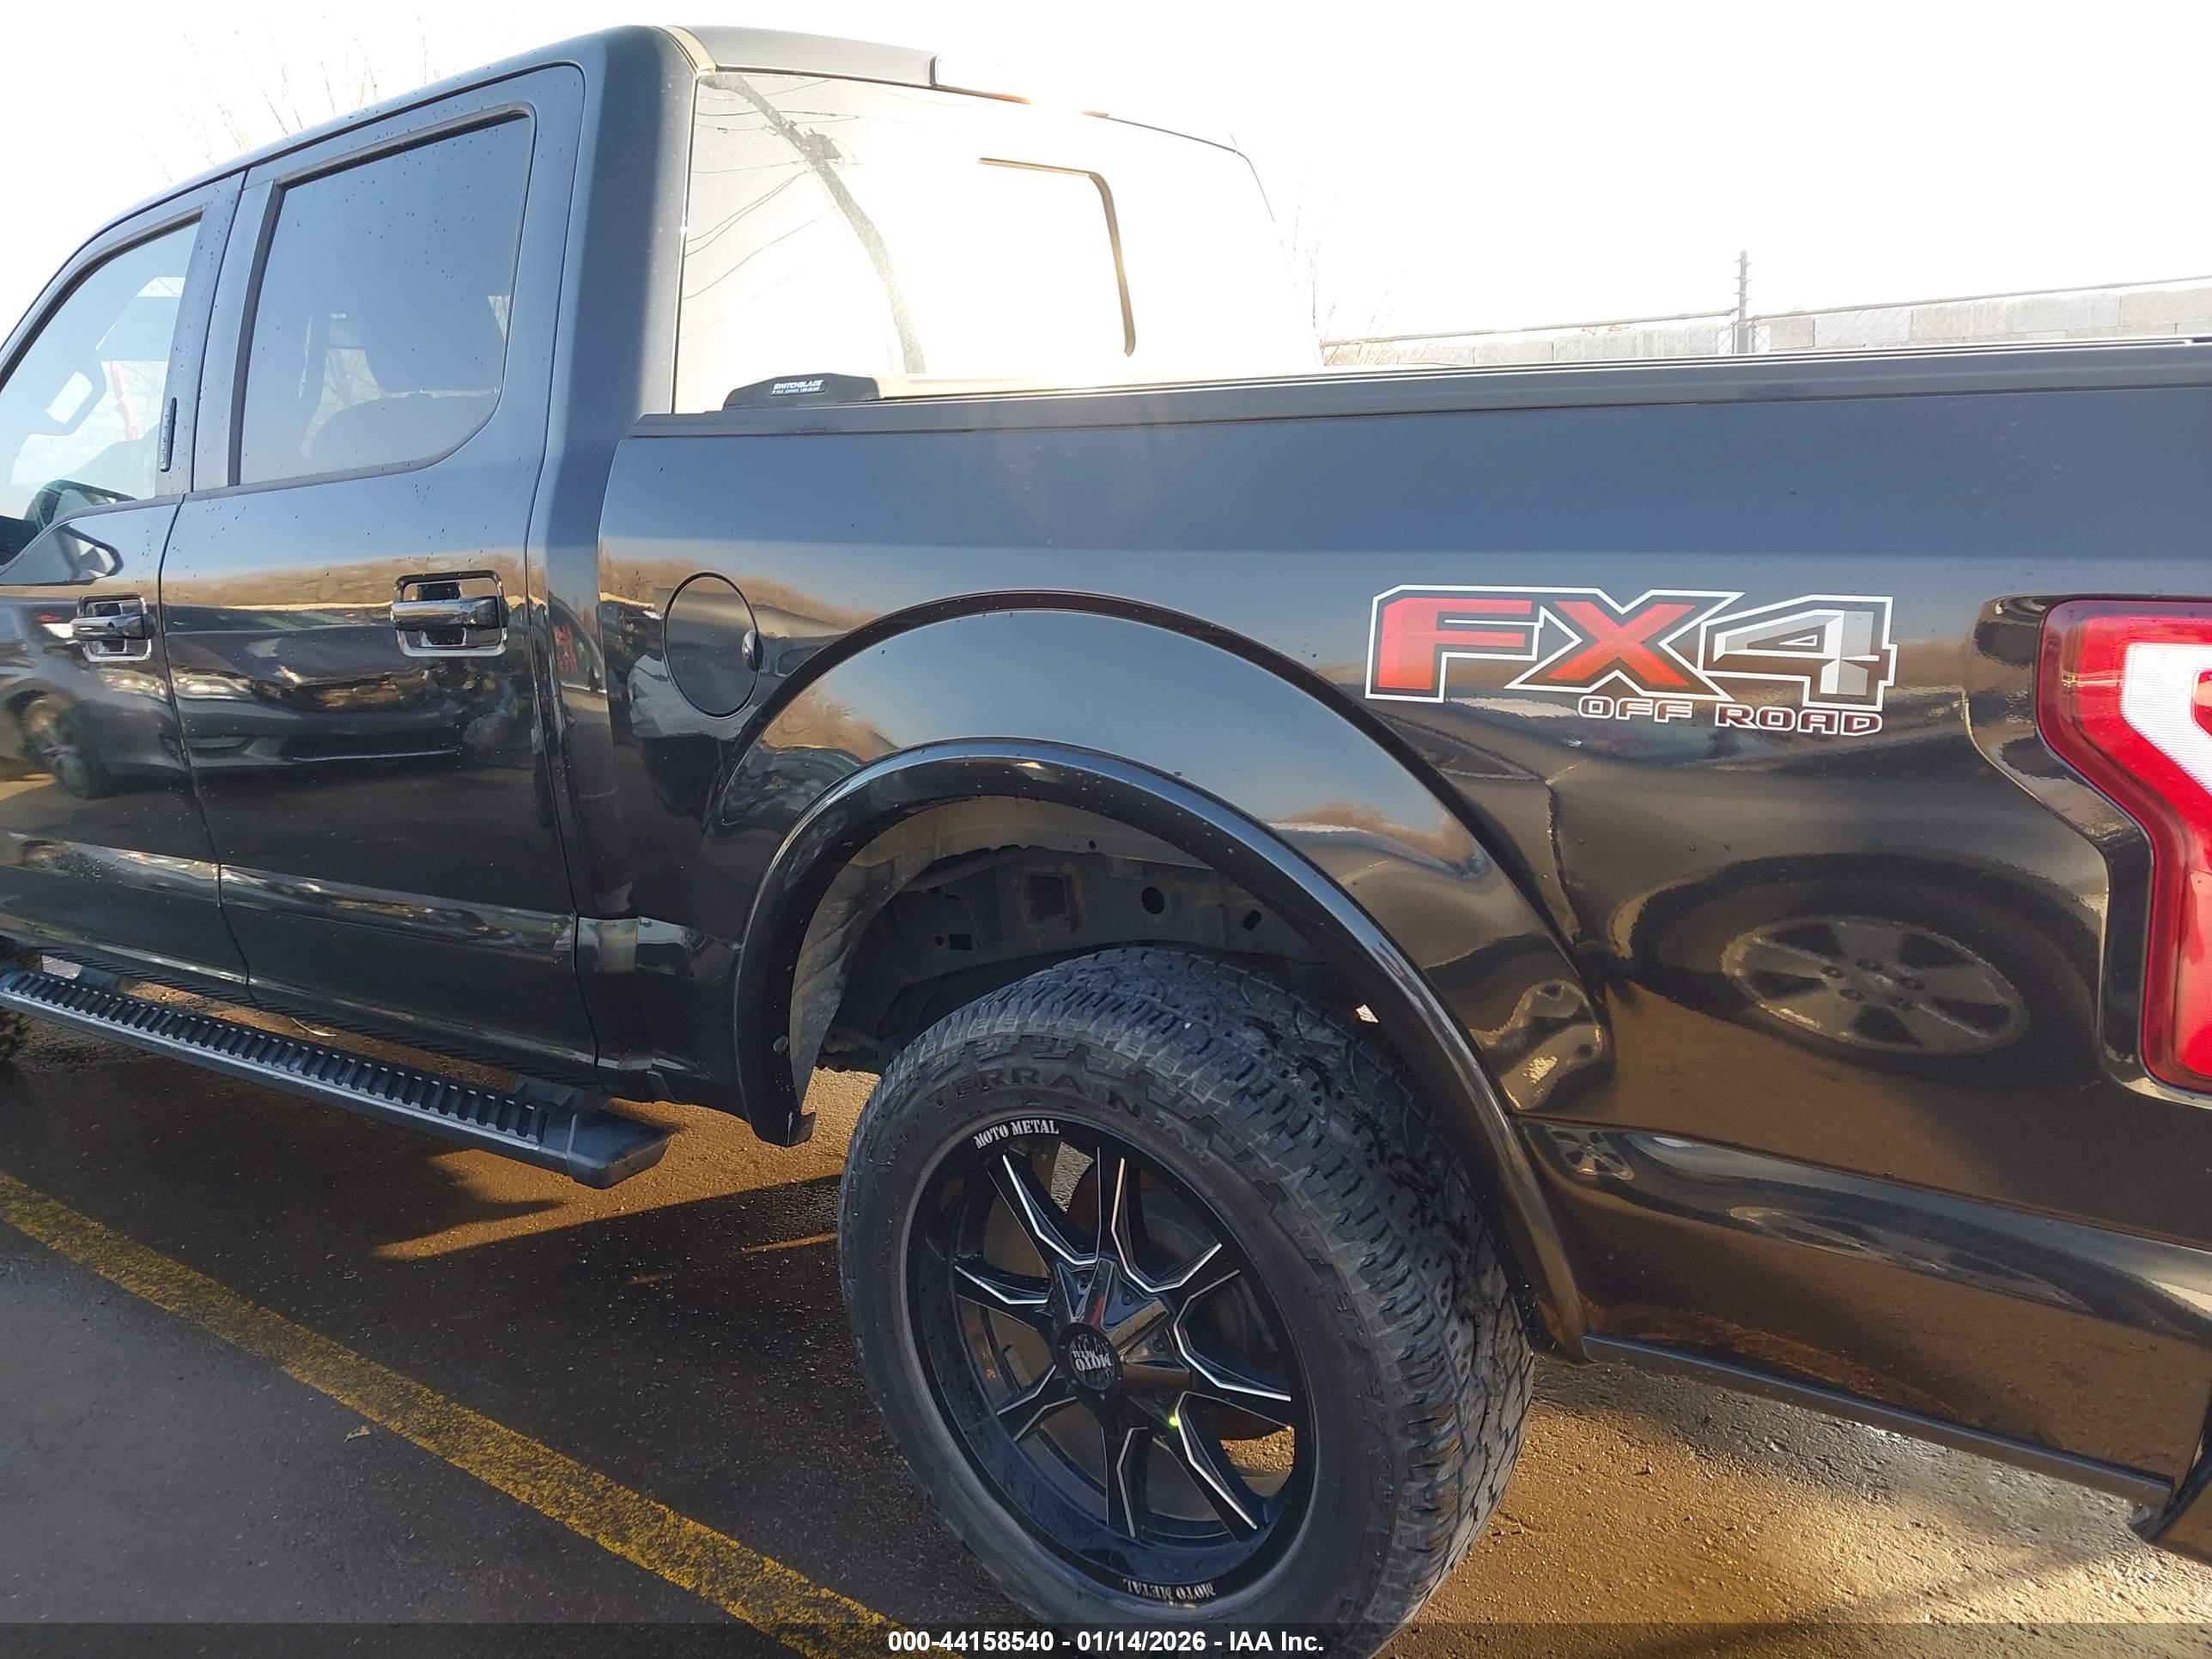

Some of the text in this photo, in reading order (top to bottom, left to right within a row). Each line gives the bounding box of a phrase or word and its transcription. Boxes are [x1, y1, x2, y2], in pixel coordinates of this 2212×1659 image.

[1365, 585, 1898, 710] FX4
[1577, 696, 1883, 736] OFF ROAD
[927, 1066, 1144, 1119] TERRAIN
[973, 1119, 1060, 1150] MOTO METAL
[1075, 1352, 1114, 1371] MOTO
[1122, 1578, 1217, 1600] MOTO METAL
